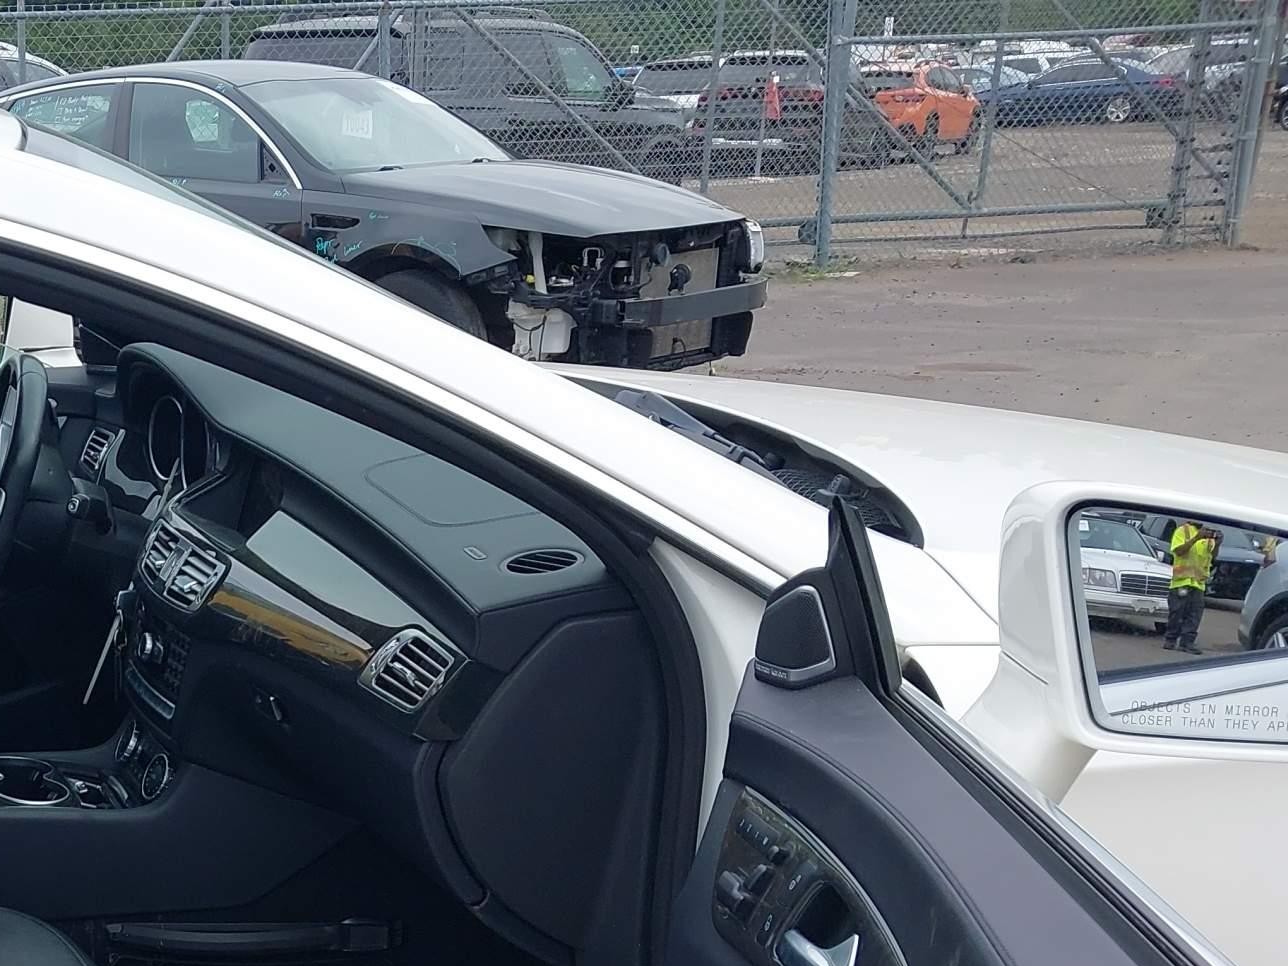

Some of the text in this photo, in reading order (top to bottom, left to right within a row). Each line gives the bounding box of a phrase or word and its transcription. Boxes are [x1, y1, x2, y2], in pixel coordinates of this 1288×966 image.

[1131, 700, 1279, 717] OBJECTS IN MIRROR
[1121, 714, 1288, 732] CLOSER THAN THEY AP
